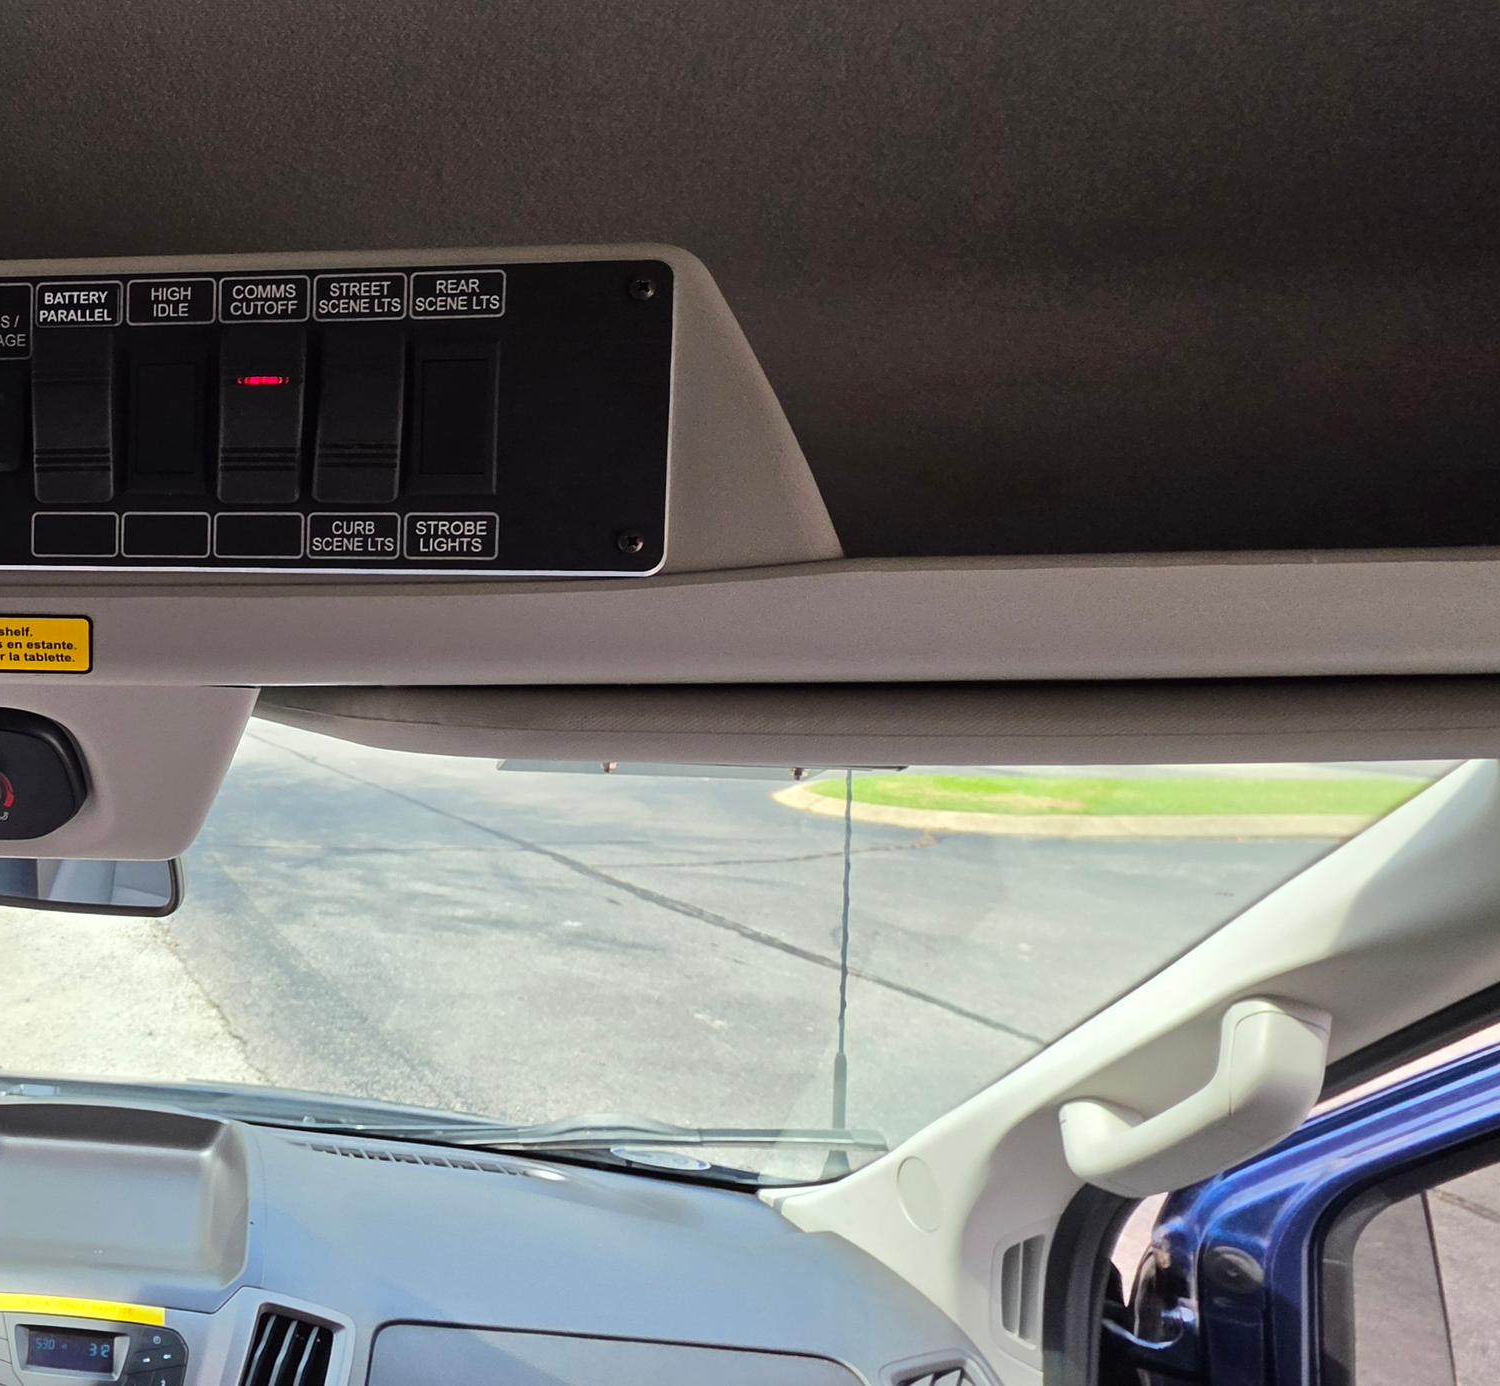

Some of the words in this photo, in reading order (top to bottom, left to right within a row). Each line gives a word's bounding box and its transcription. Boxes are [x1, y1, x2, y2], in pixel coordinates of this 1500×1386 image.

[232, 284, 296, 299] COMMS
[330, 282, 391, 297] STREET
[436, 278, 480, 293] REAR
[44, 291, 108, 305] BATTERY
[151, 287, 191, 301] HIGH
[153, 303, 188, 318] IDLE
[230, 300, 297, 315] CUTOFF
[319, 298, 372, 314] SCENE
[376, 298, 401, 313] LTS
[416, 296, 468, 311] SCENE
[472, 295, 500, 310] LTS
[12, 315, 19, 329] /
[40, 308, 112, 322] PARALLEL
[332, 521, 375, 535] CURB
[416, 520, 487, 535] STROBE
[312, 537, 365, 552] SCENE
[368, 537, 394, 552] LTS
[420, 537, 482, 553] LIGHTS
[7, 641, 23, 649] en
[26, 640, 77, 650] estante.
[9, 652, 20, 661] la
[24, 652, 76, 663] tablette.
